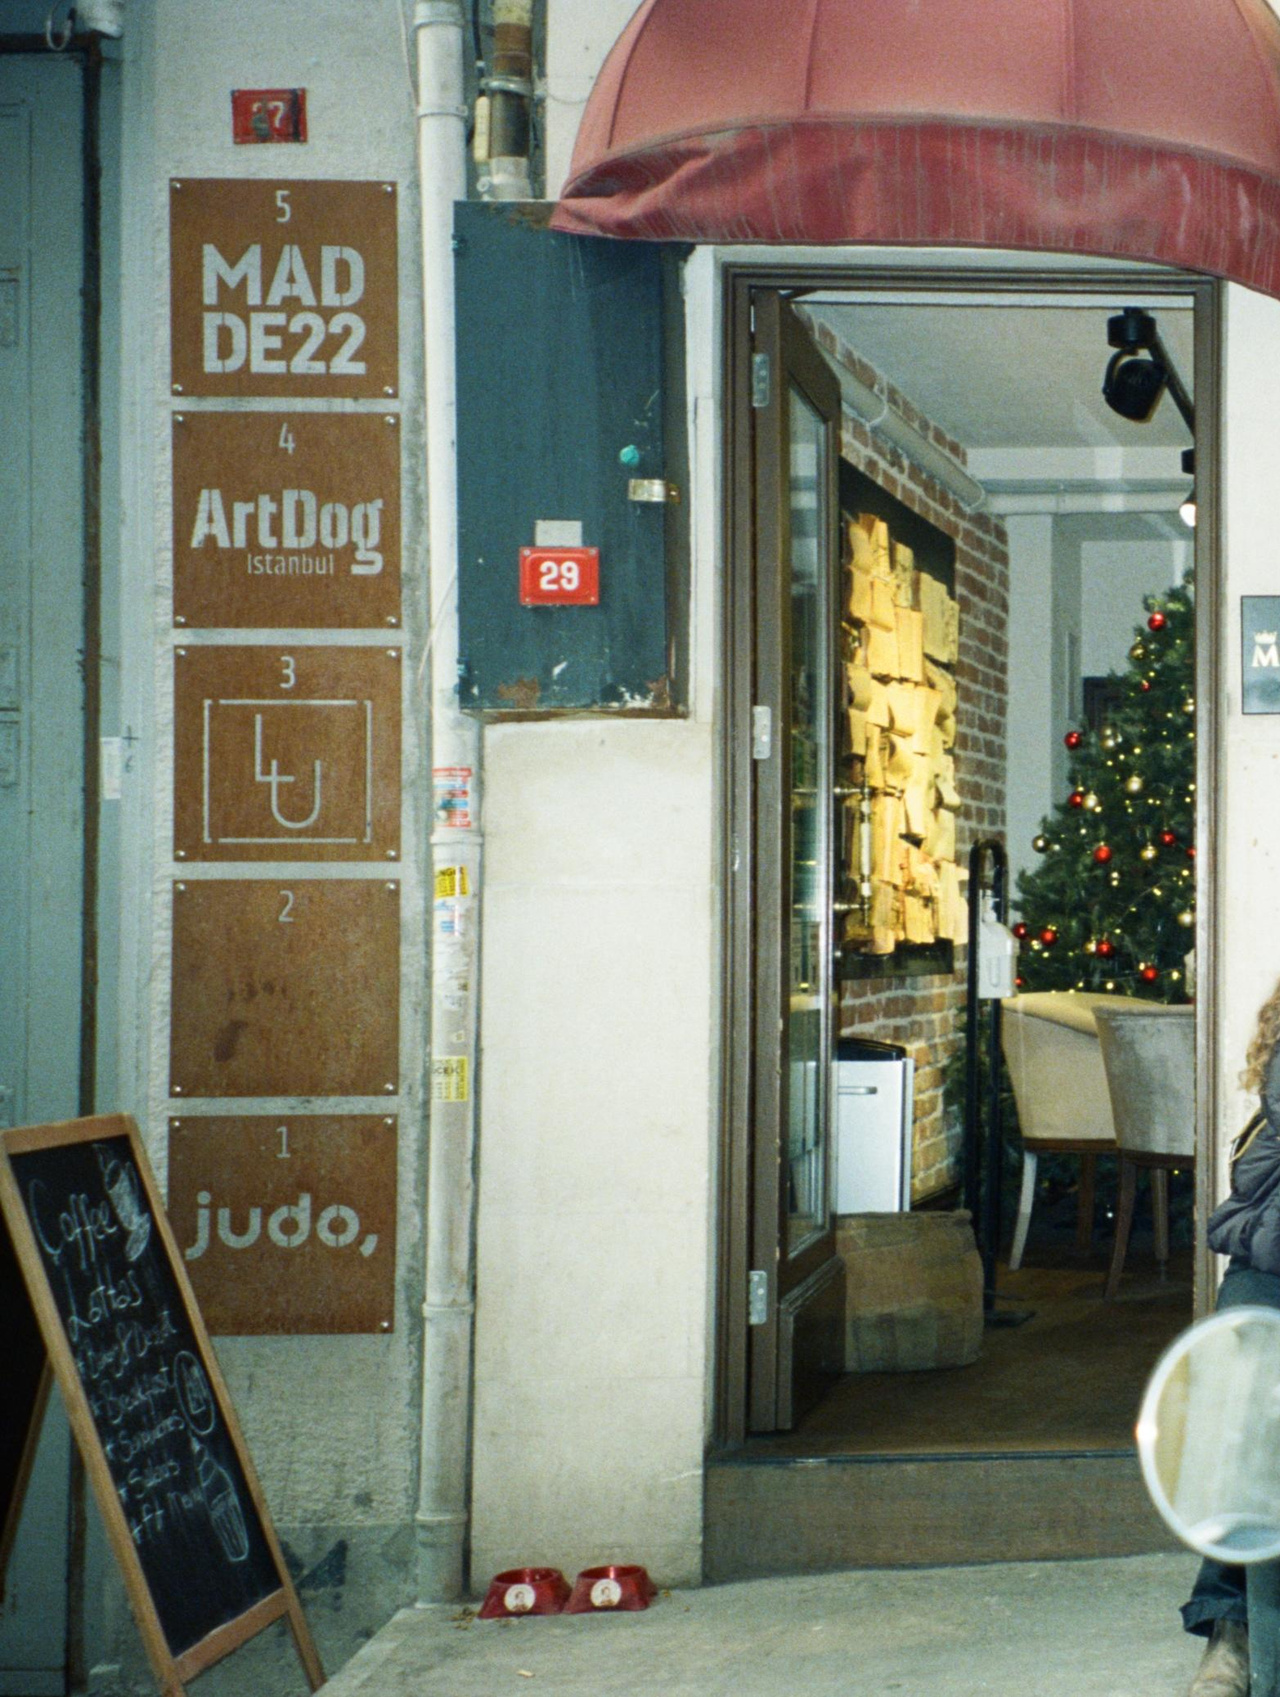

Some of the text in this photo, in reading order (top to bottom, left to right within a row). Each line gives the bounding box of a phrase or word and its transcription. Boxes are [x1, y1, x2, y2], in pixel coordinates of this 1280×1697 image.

[276, 190, 291, 223] 5
[203, 243, 365, 306] MAD
[203, 311, 367, 375] DE22
[279, 422, 295, 454] 4
[191, 488, 384, 575] ArtDog
[540, 560, 580, 591] 29
[280, 655, 295, 689] 3
[279, 890, 294, 922] 2
[276, 1126, 291, 1158] 1
[29, 1179, 118, 1270] Coffee
